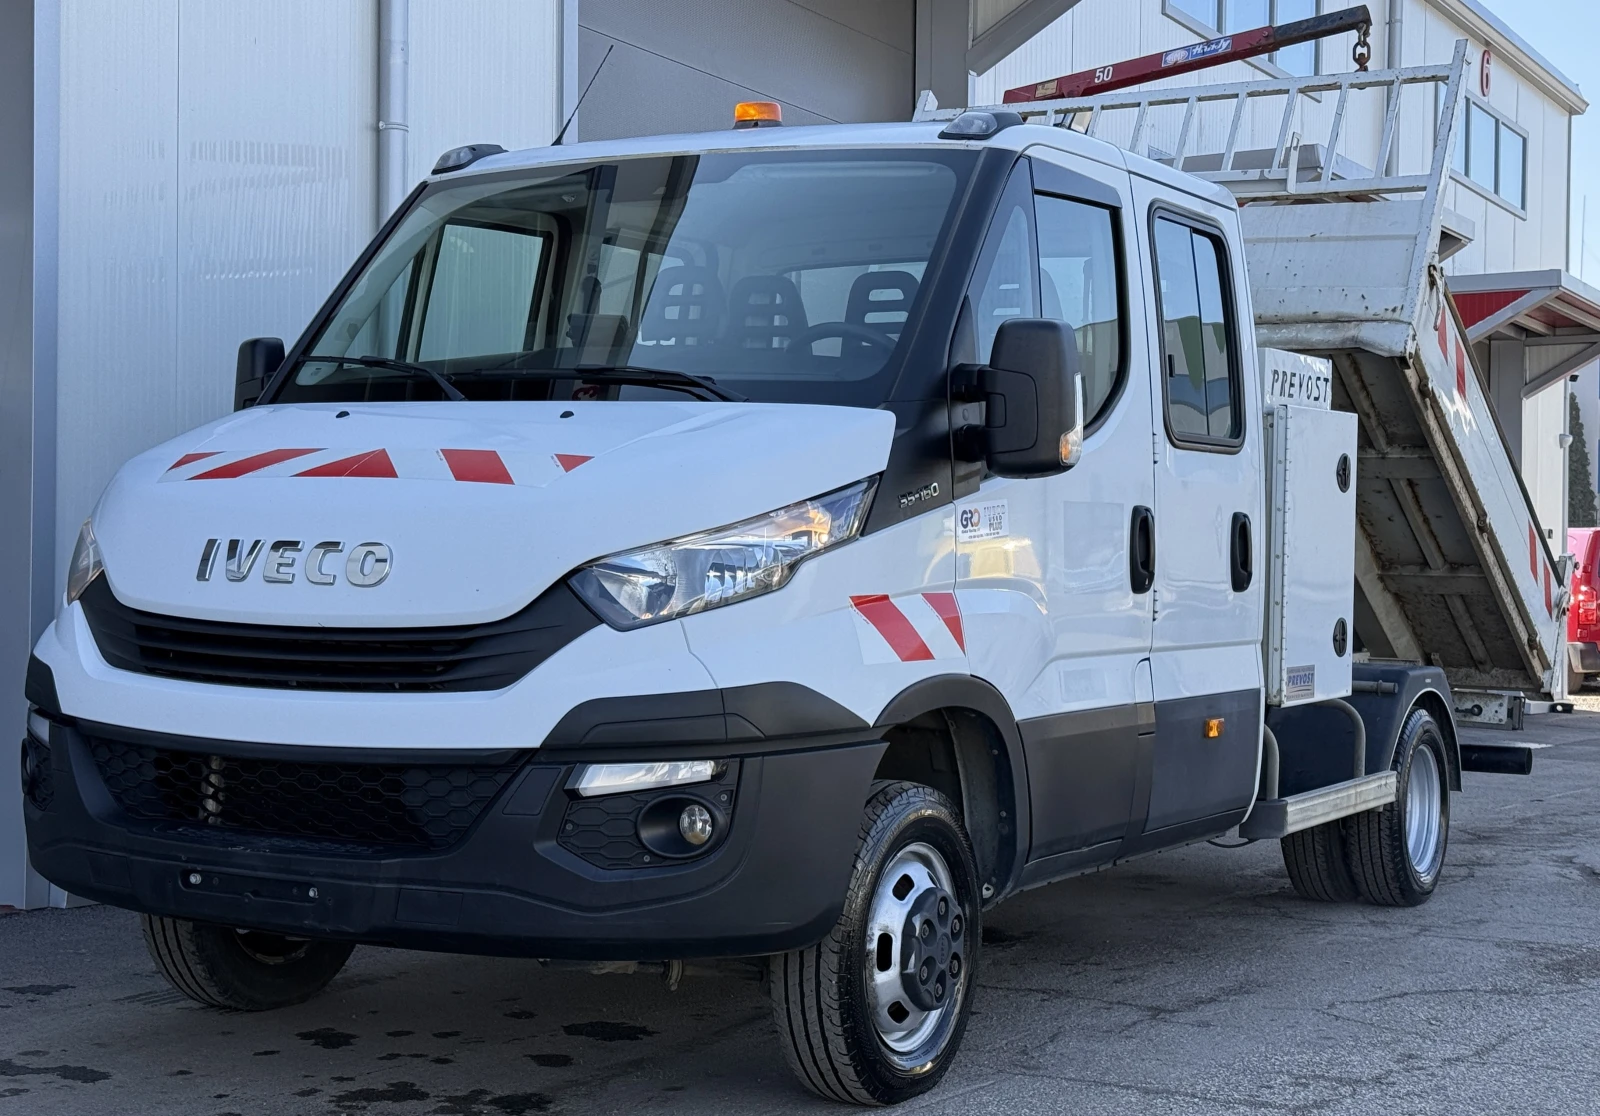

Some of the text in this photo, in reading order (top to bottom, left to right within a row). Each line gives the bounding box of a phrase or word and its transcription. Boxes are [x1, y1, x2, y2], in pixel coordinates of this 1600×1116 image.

[1094, 66, 1113, 83] 50
[1481, 49, 1491, 97] 6
[1271, 369, 1329, 402] PREVOST
[960, 508, 981, 529] GRO
[989, 521, 1003, 531] PLUS
[196, 539, 394, 588] IVECO
[1288, 673, 1314, 686] PREVOST
